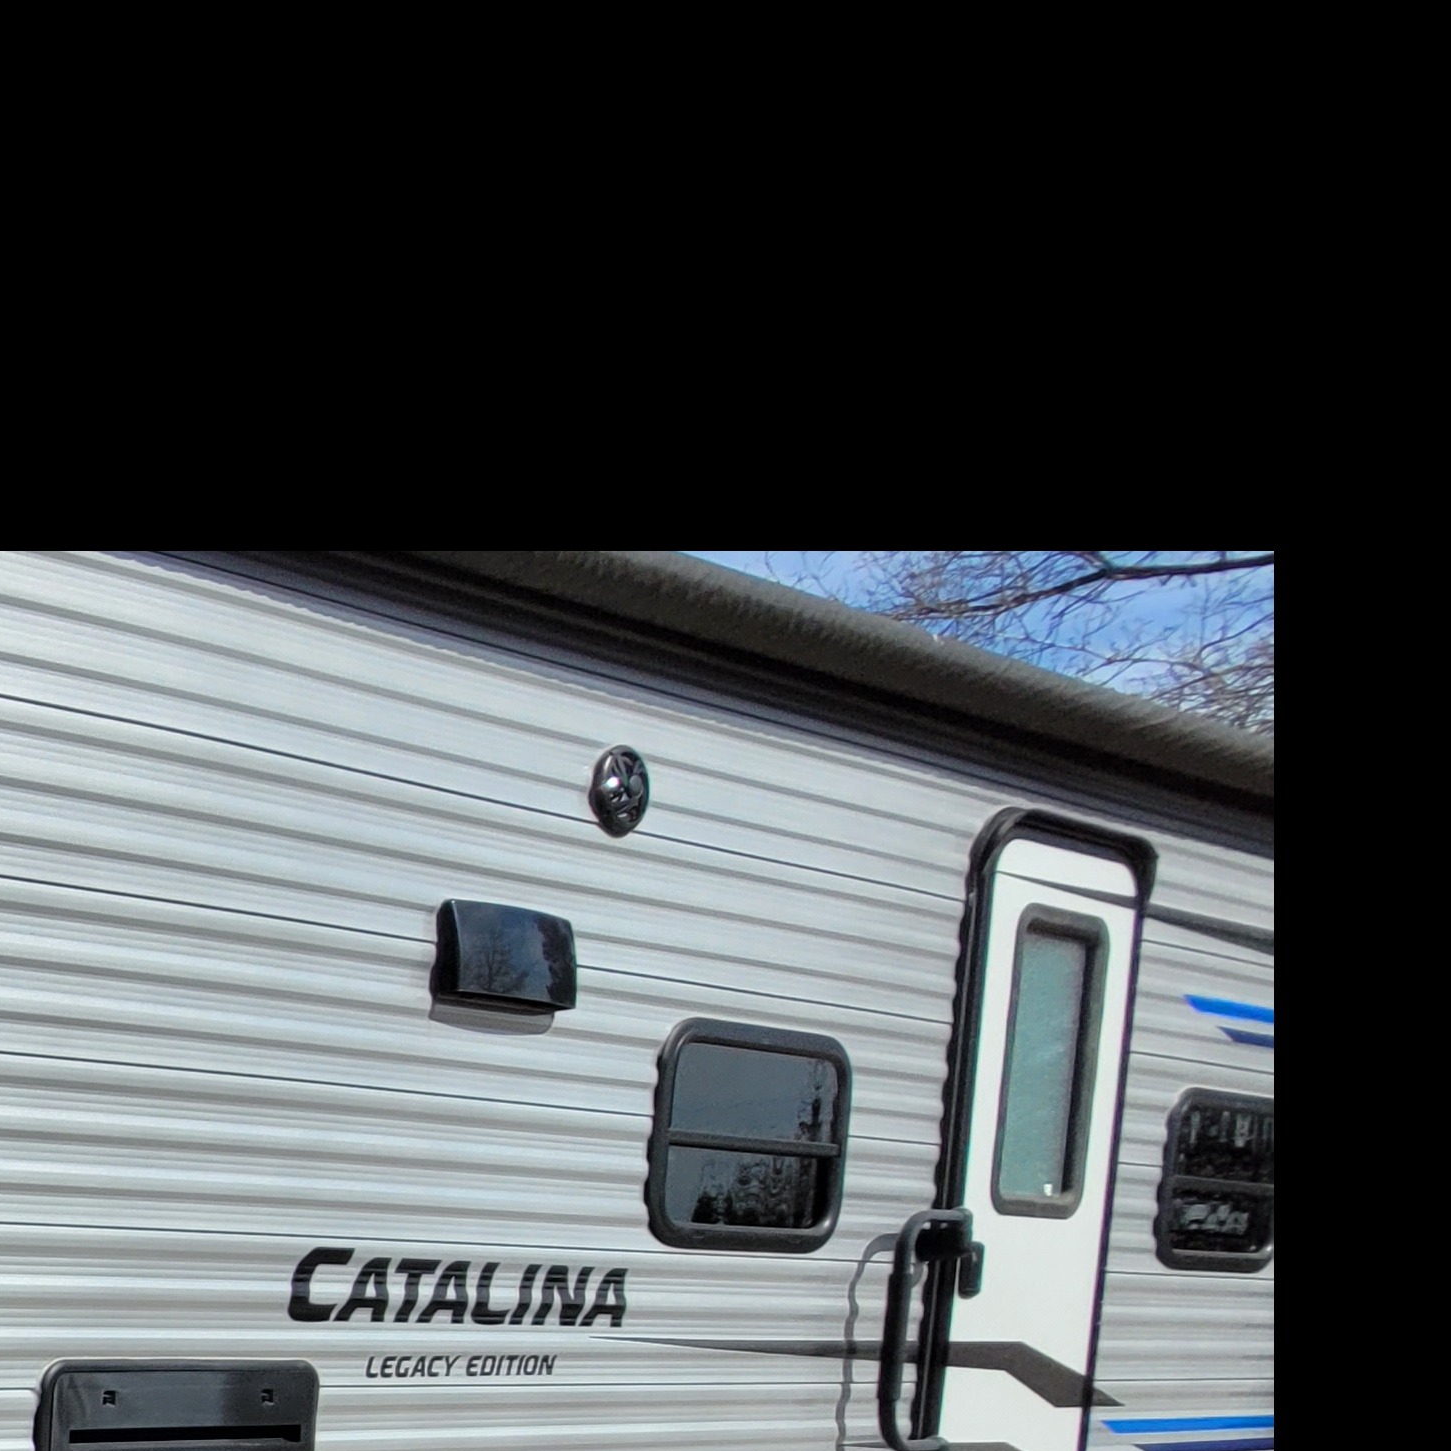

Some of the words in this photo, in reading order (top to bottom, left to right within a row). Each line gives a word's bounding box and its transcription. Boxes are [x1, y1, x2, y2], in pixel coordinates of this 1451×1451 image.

[287, 1246, 628, 1328] CATALINA
[365, 1355, 462, 1379] LEGACY
[466, 1354, 557, 1378] EDITION
